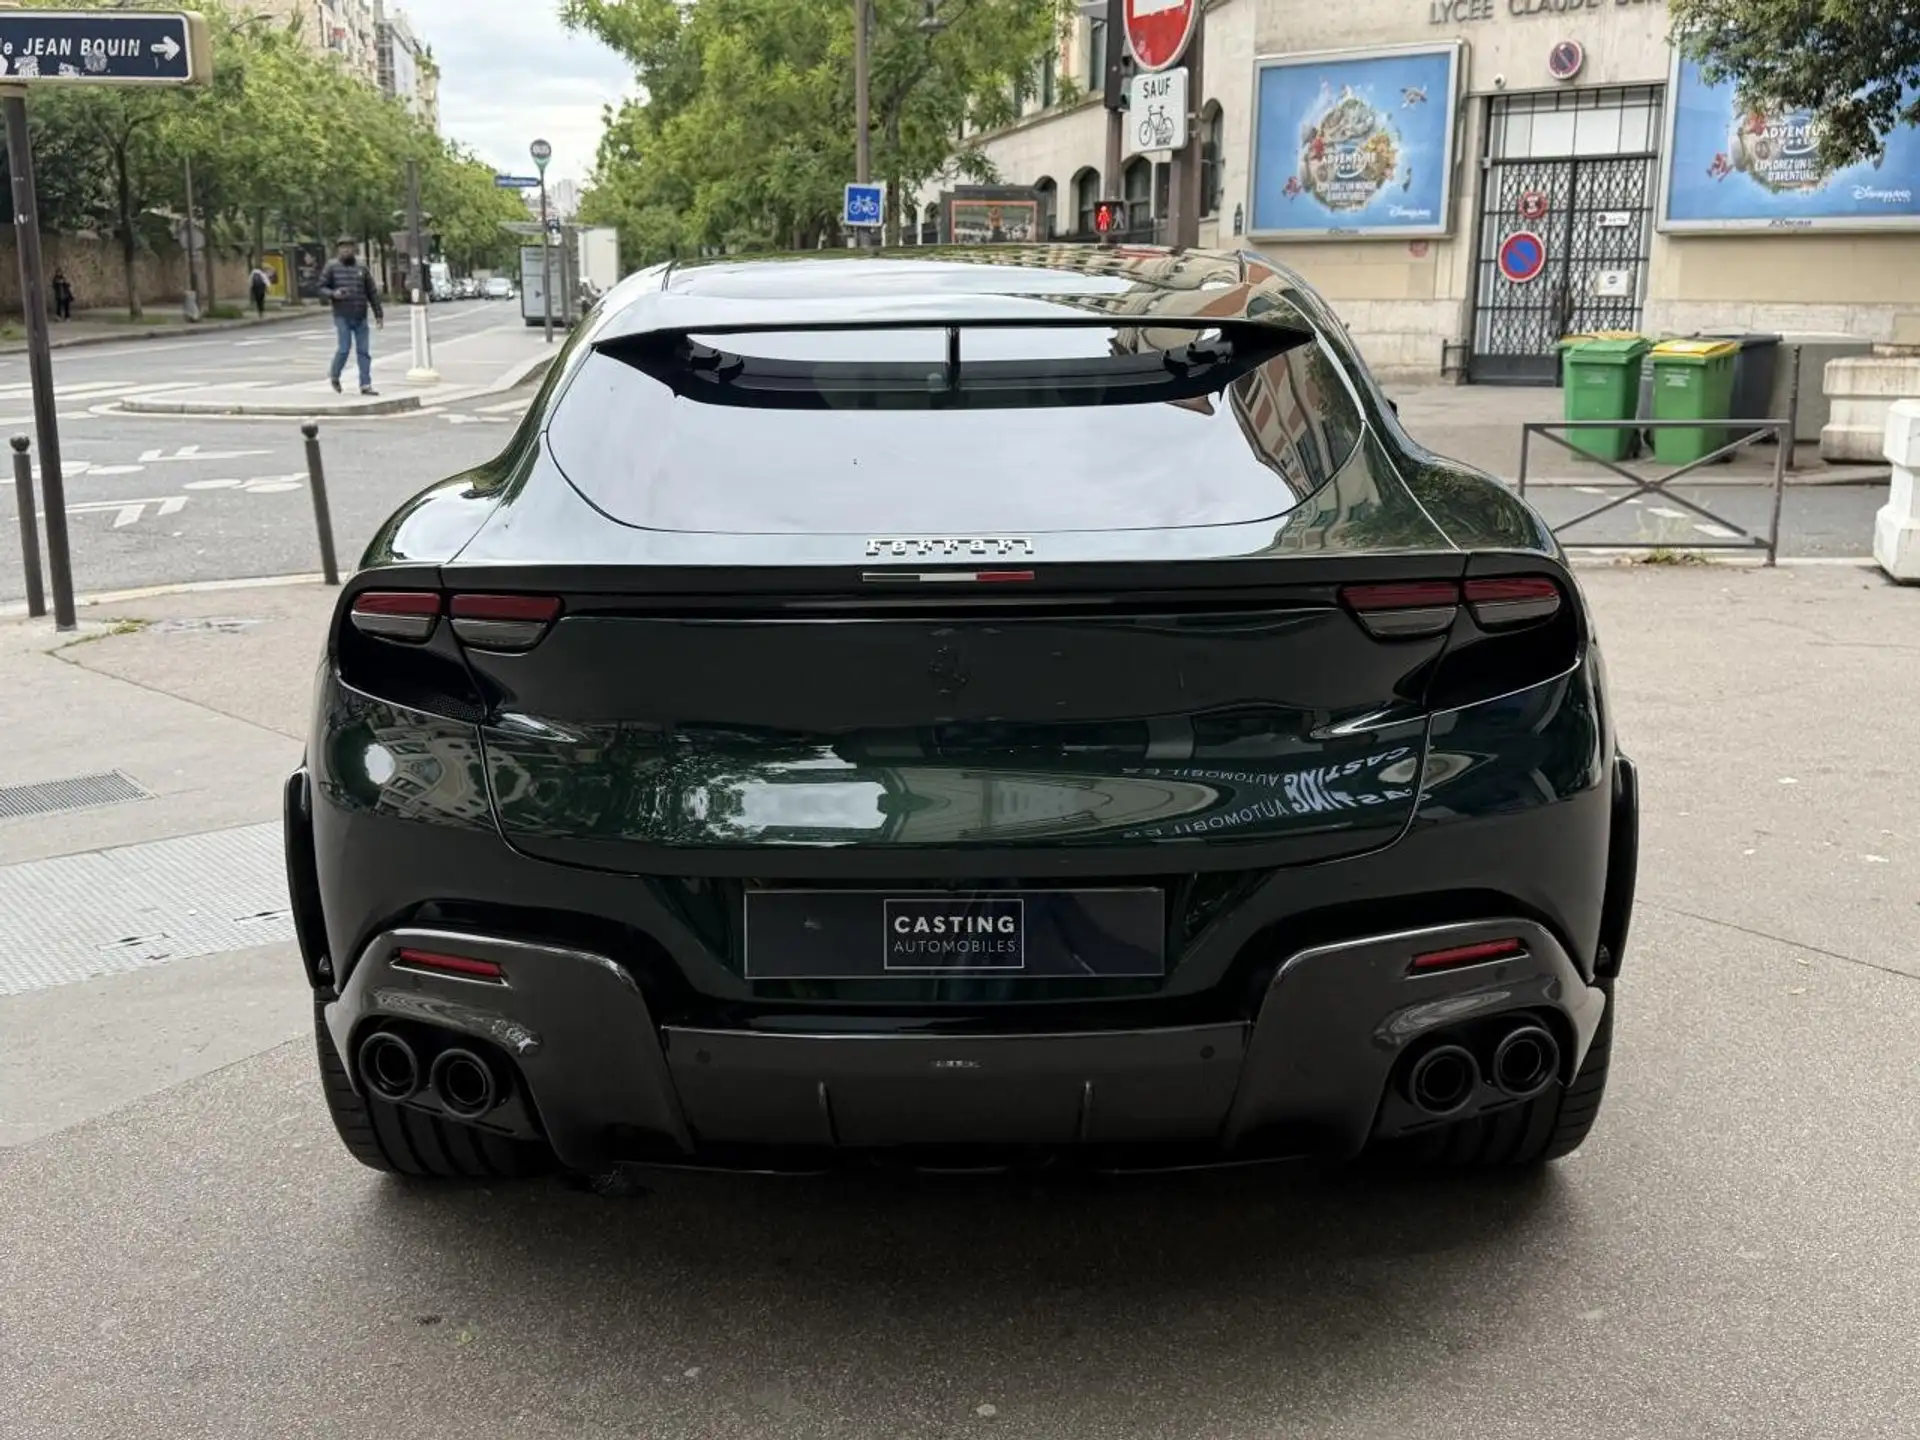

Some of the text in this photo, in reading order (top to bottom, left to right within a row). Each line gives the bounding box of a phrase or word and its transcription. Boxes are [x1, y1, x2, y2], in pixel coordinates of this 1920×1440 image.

[23, 38, 71, 56] JEAN
[80, 38, 140, 57] BOUIN
[1142, 78, 1171, 98] SAUF
[865, 537, 1034, 556] Ferrari
[894, 915, 1016, 934] CASTING
[893, 940, 1016, 953] AUTOMOBILES
